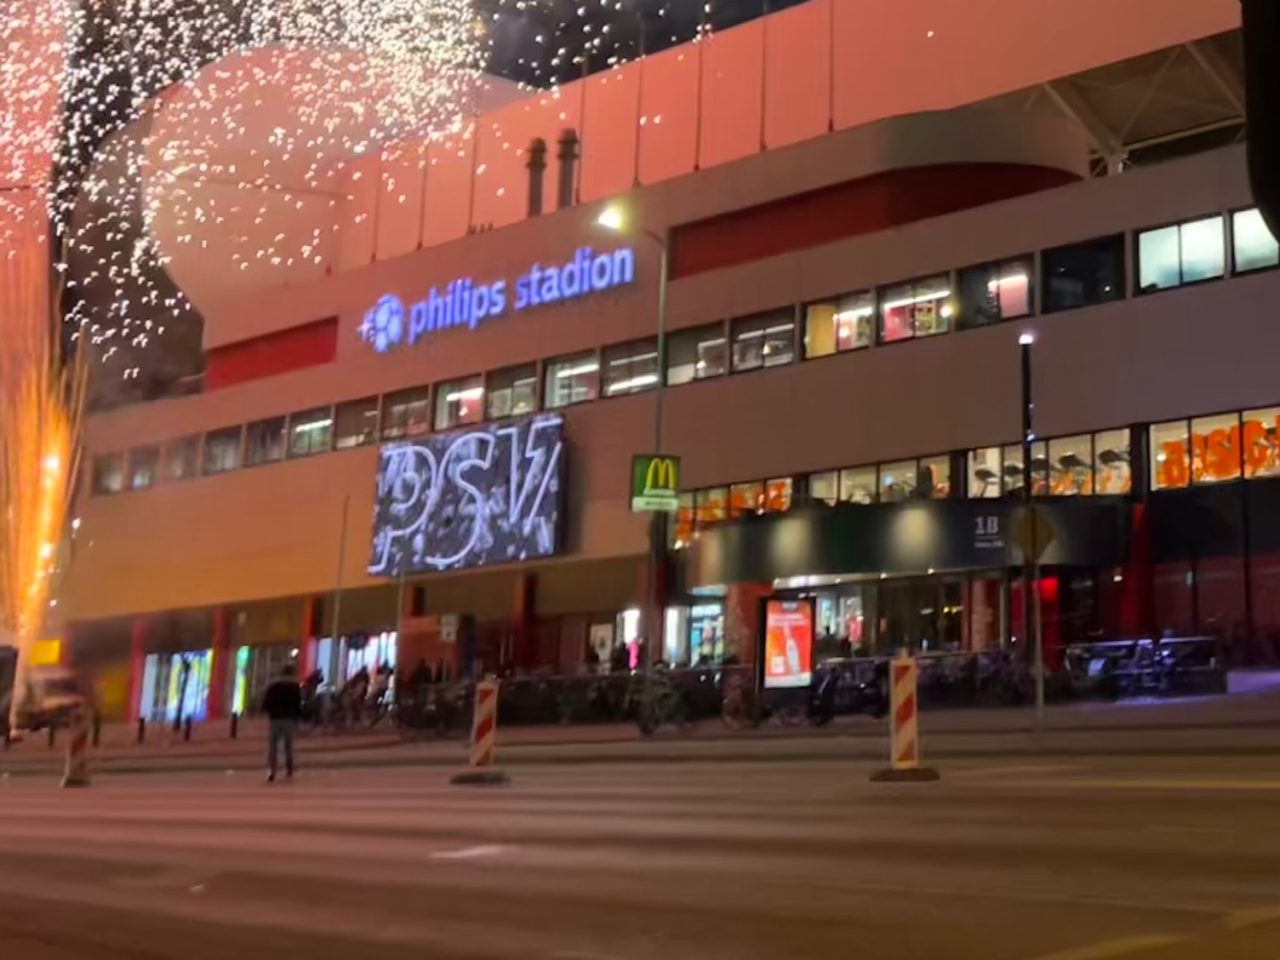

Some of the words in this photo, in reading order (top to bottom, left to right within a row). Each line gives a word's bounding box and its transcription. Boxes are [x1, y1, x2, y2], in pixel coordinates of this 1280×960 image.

[408, 277, 505, 344] philips
[514, 246, 635, 310] stadion
[368, 415, 565, 573] PSV
